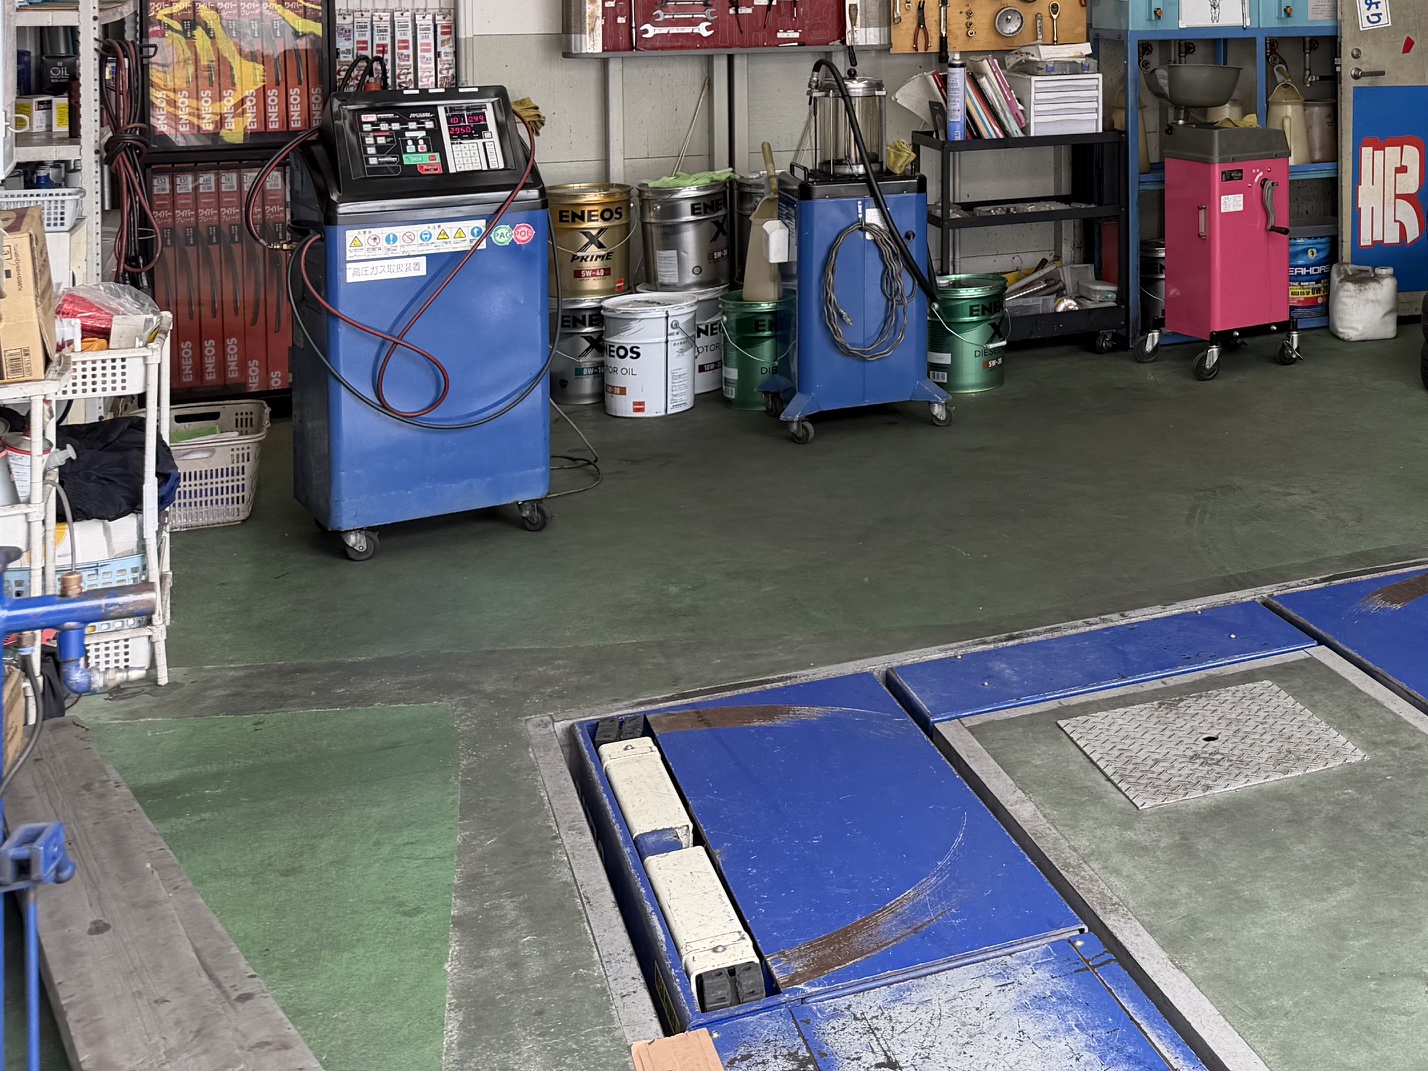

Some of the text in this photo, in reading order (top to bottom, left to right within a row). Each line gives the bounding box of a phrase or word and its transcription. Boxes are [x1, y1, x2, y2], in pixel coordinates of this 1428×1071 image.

[179, 90, 189, 131] ENEOS
[201, 89, 212, 130] ENEOS
[224, 89, 234, 130] ENEOS
[247, 88, 257, 130] ENEOS
[269, 88, 279, 129] ENEOS
[291, 87, 301, 128] ENEOS
[313, 87, 322, 127] ENEOS
[559, 207, 623, 223] ENEOS
[493, 230, 513, 239] PAG
[515, 229, 531, 238] POE
[570, 252, 613, 263] PRIME
[581, 269, 604, 277] 5W-40
[1289, 265, 1330, 275] EAHORS
[968, 301, 1001, 317] ENE
[561, 314, 601, 328] ENE
[697, 343, 720, 354] OTOR
[974, 348, 1000, 358] DIESE
[182, 340, 193, 382] ENEOS
[205, 339, 216, 380] ENEOS
[227, 337, 238, 378] ENEOS
[249, 359, 259, 391] NEOS
[620, 367, 637, 376] OIL
[761, 366, 778, 374] DIE
